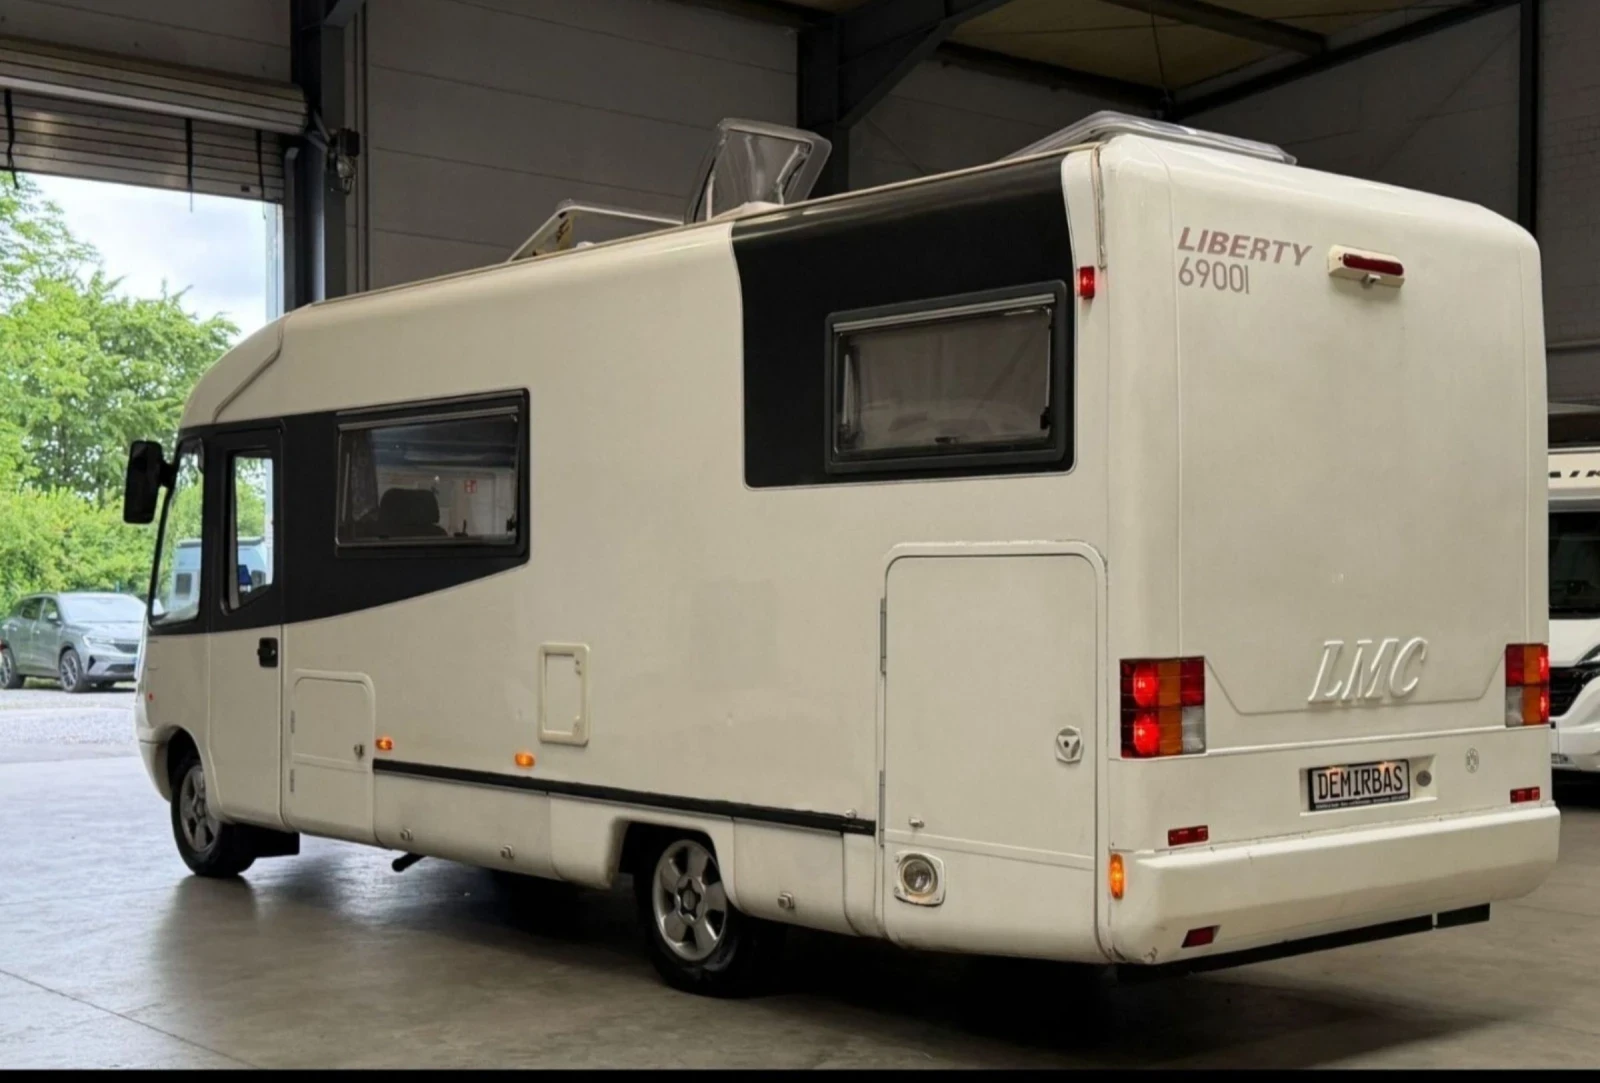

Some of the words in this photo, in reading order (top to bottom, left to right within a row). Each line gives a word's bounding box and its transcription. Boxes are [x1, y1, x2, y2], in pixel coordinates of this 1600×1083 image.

[1177, 227, 1312, 266] LIBERTY
[1308, 636, 1429, 704] LMC
[1317, 764, 1404, 800] DEMIRBAS
